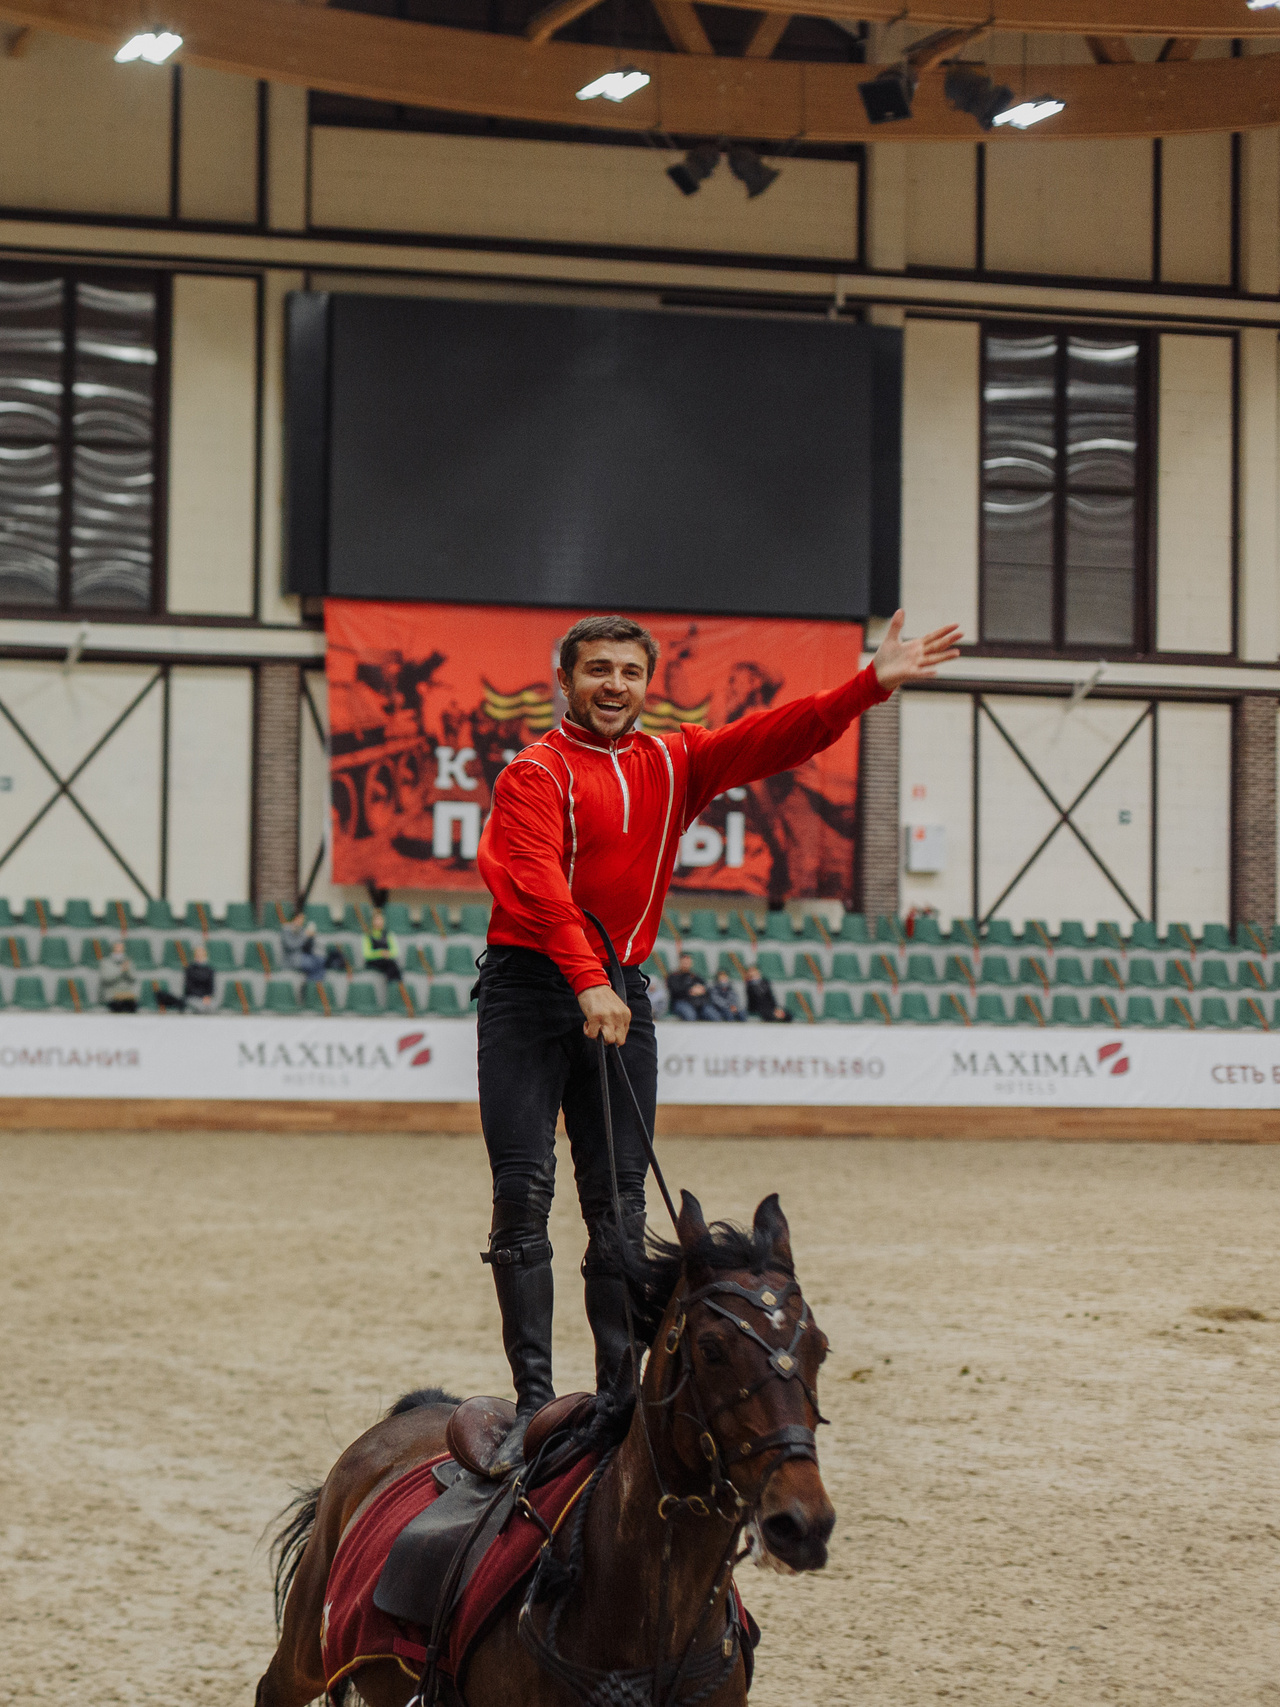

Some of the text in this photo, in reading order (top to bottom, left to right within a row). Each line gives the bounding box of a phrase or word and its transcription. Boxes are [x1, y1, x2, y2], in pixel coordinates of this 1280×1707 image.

[237, 1041, 393, 1070] MAXIMA
[663, 1053, 885, 1080] ОТ ШЕРЕМЕТЬЕВО
[951, 1051, 1095, 1078] MAXIMA
[1211, 1064, 1265, 1084] СЕТЬ
